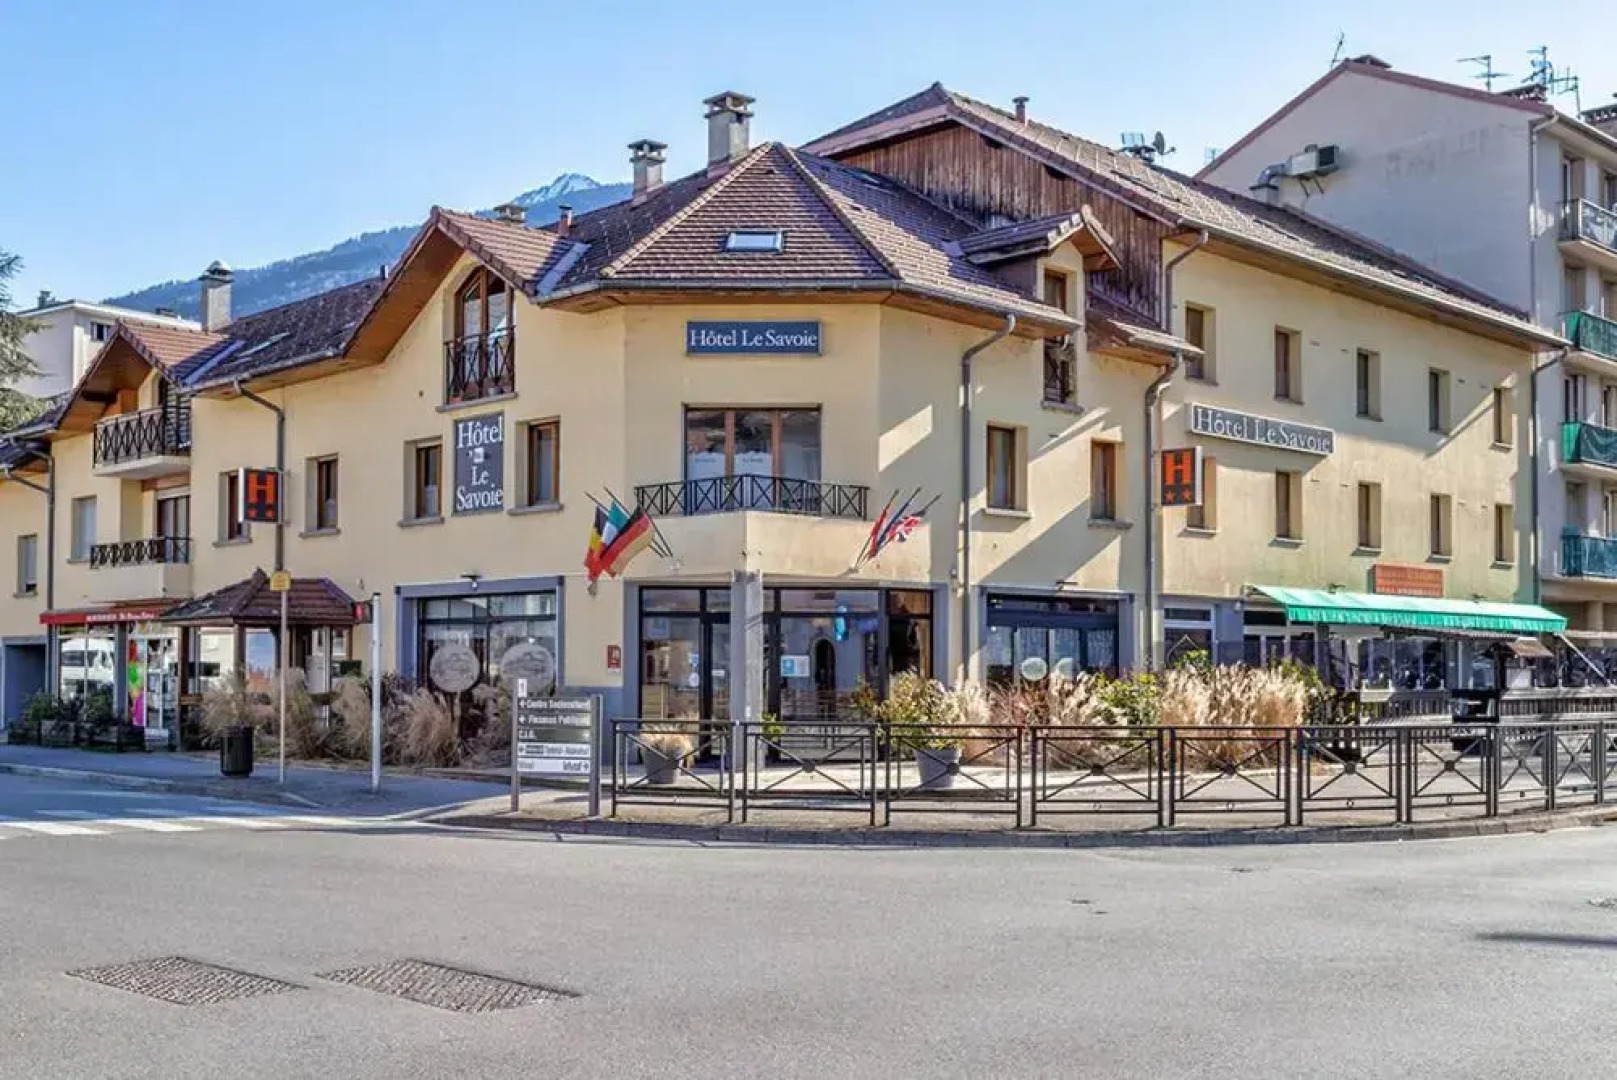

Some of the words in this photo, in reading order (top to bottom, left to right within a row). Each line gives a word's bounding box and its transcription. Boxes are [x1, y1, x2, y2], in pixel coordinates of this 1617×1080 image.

[690, 329, 737, 347] Hôtel
[741, 329, 764, 347] Le
[765, 329, 818, 347] Savoie
[457, 416, 504, 449] Hôtel
[1197, 408, 1248, 439] Hôtel
[1254, 418, 1277, 443] Le
[1280, 423, 1331, 452] Savoie
[471, 465, 490, 486] Le
[1164, 453, 1192, 485] H
[248, 471, 276, 504] H
[456, 482, 504, 511] Savoie
